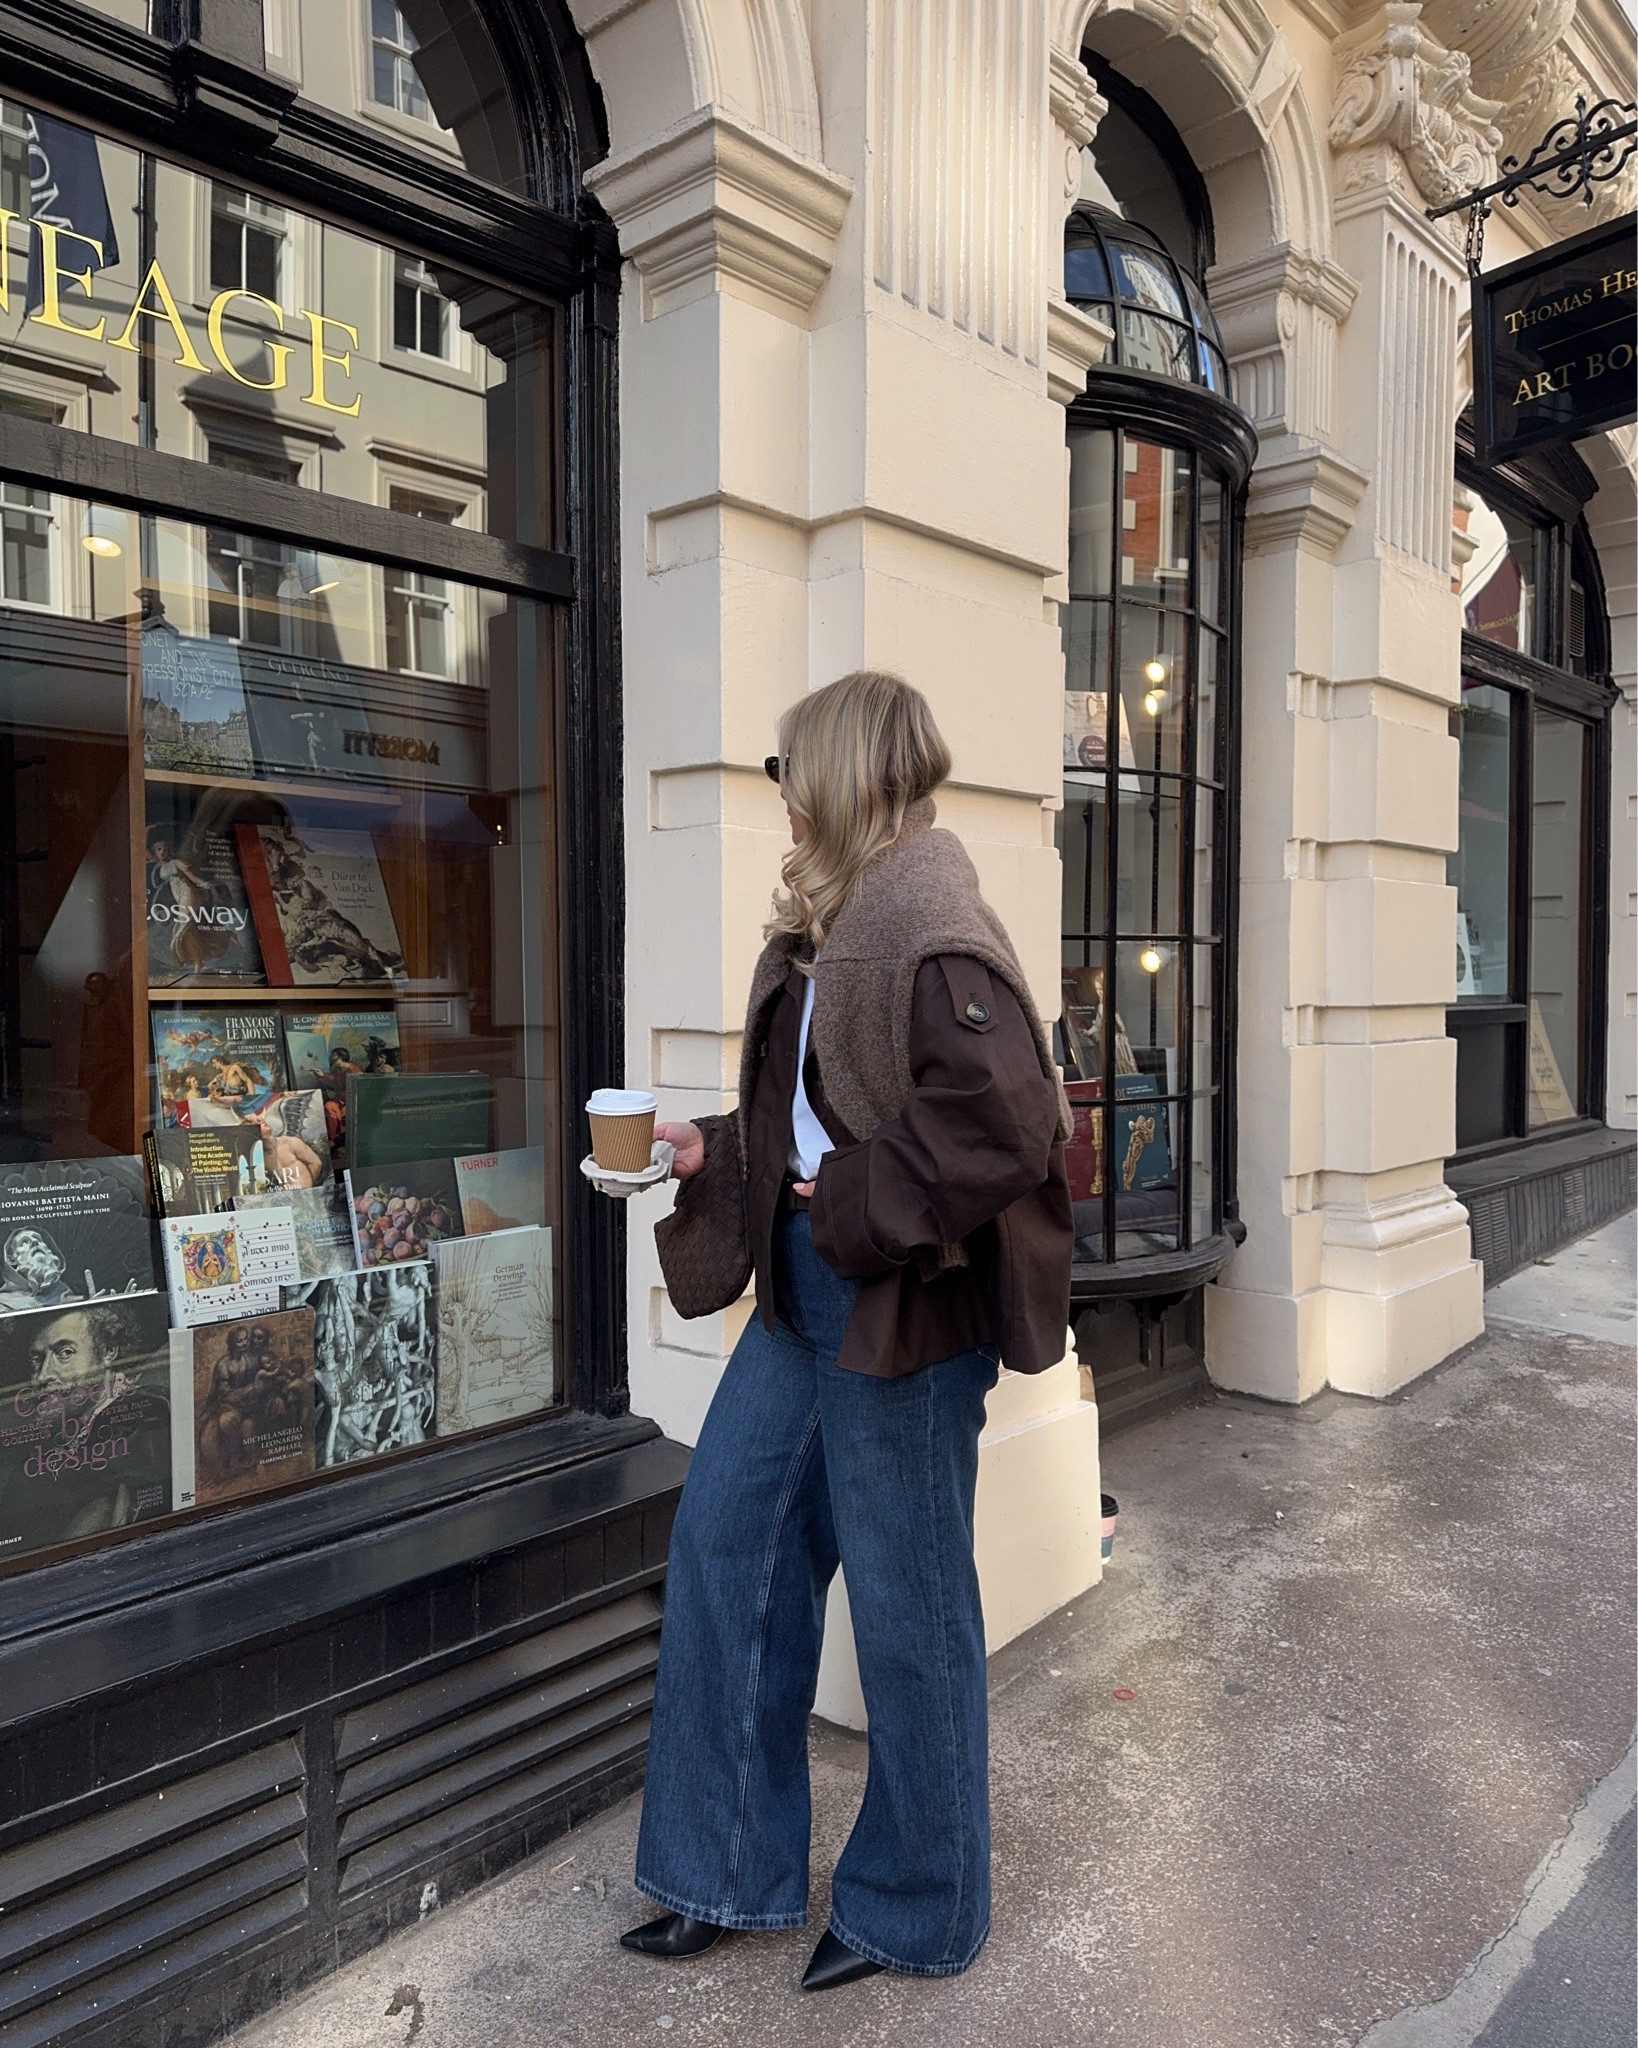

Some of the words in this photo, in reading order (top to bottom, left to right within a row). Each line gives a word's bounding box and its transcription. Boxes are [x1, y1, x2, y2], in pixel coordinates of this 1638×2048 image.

[1505, 288, 1593, 335] THOMAS
[1512, 361, 1577, 406] ART
[1585, 343, 1638, 381] BO
[161, 648, 183, 665] AND
[187, 650, 215, 669] THE
[212, 669, 235, 686] CITY
[173, 681, 216, 700] SCAPE
[333, 881, 351, 892] Van
[352, 882, 375, 894] Dyck
[146, 903, 249, 931] osway
[301, 1015, 352, 1024] CINQUECENTO
[226, 1028, 239, 1040] LE
[241, 1028, 276, 1040] MOYNE
[207, 1152, 233, 1160] Academy
[461, 1157, 499, 1171] TURNER
[39, 1183, 69, 1192] Acclaimed
[0, 1199, 39, 1209] IOVANNI
[41, 1195, 82, 1206] BATTISTA
[83, 1192, 110, 1202] MAINI
[36, 1204, 72, 1213] (1690-1752)
[12, 1214, 35, 1222] ROMAN
[36, 1210, 72, 1220] SCULPTURE
[493, 1271, 527, 1282] Drawings
[495, 1263, 524, 1274] German
[14, 1379, 137, 1417] Careers
[100, 1404, 129, 1417] PETER
[131, 1400, 152, 1409] PAUL
[110, 1410, 144, 1424] RUBENS
[59, 1407, 96, 1445] by
[2, 1429, 51, 1447] GOLTZIUS
[242, 1425, 303, 1446] MICHELANGELO
[261, 1433, 303, 1449] LEONARDO
[268, 1441, 302, 1455] RAPHAEL
[23, 1436, 131, 1478] design
